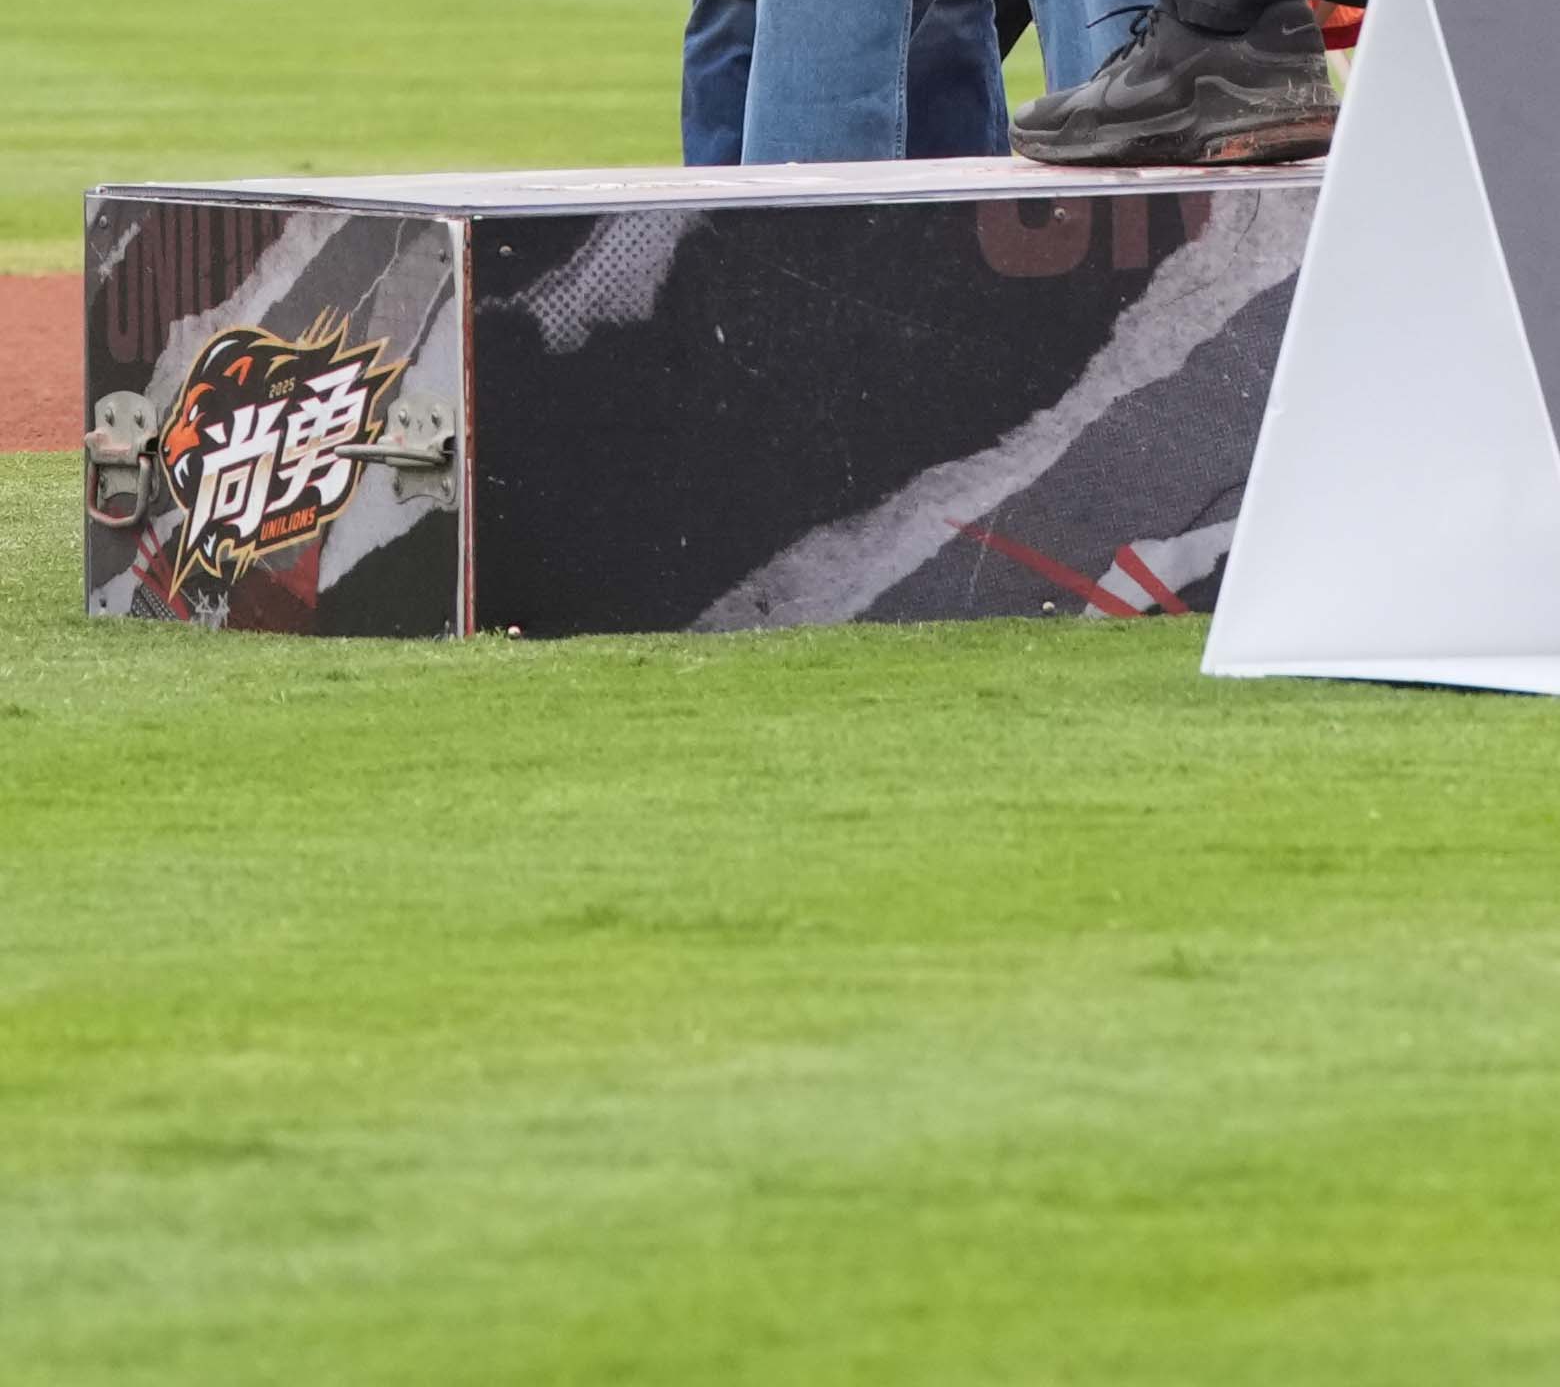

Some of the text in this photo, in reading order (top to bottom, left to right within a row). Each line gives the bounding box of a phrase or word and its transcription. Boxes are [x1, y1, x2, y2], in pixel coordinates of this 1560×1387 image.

[268, 376, 296, 399] 2025
[188, 361, 369, 549] 尚勇
[261, 505, 317, 542] UNILIONS
